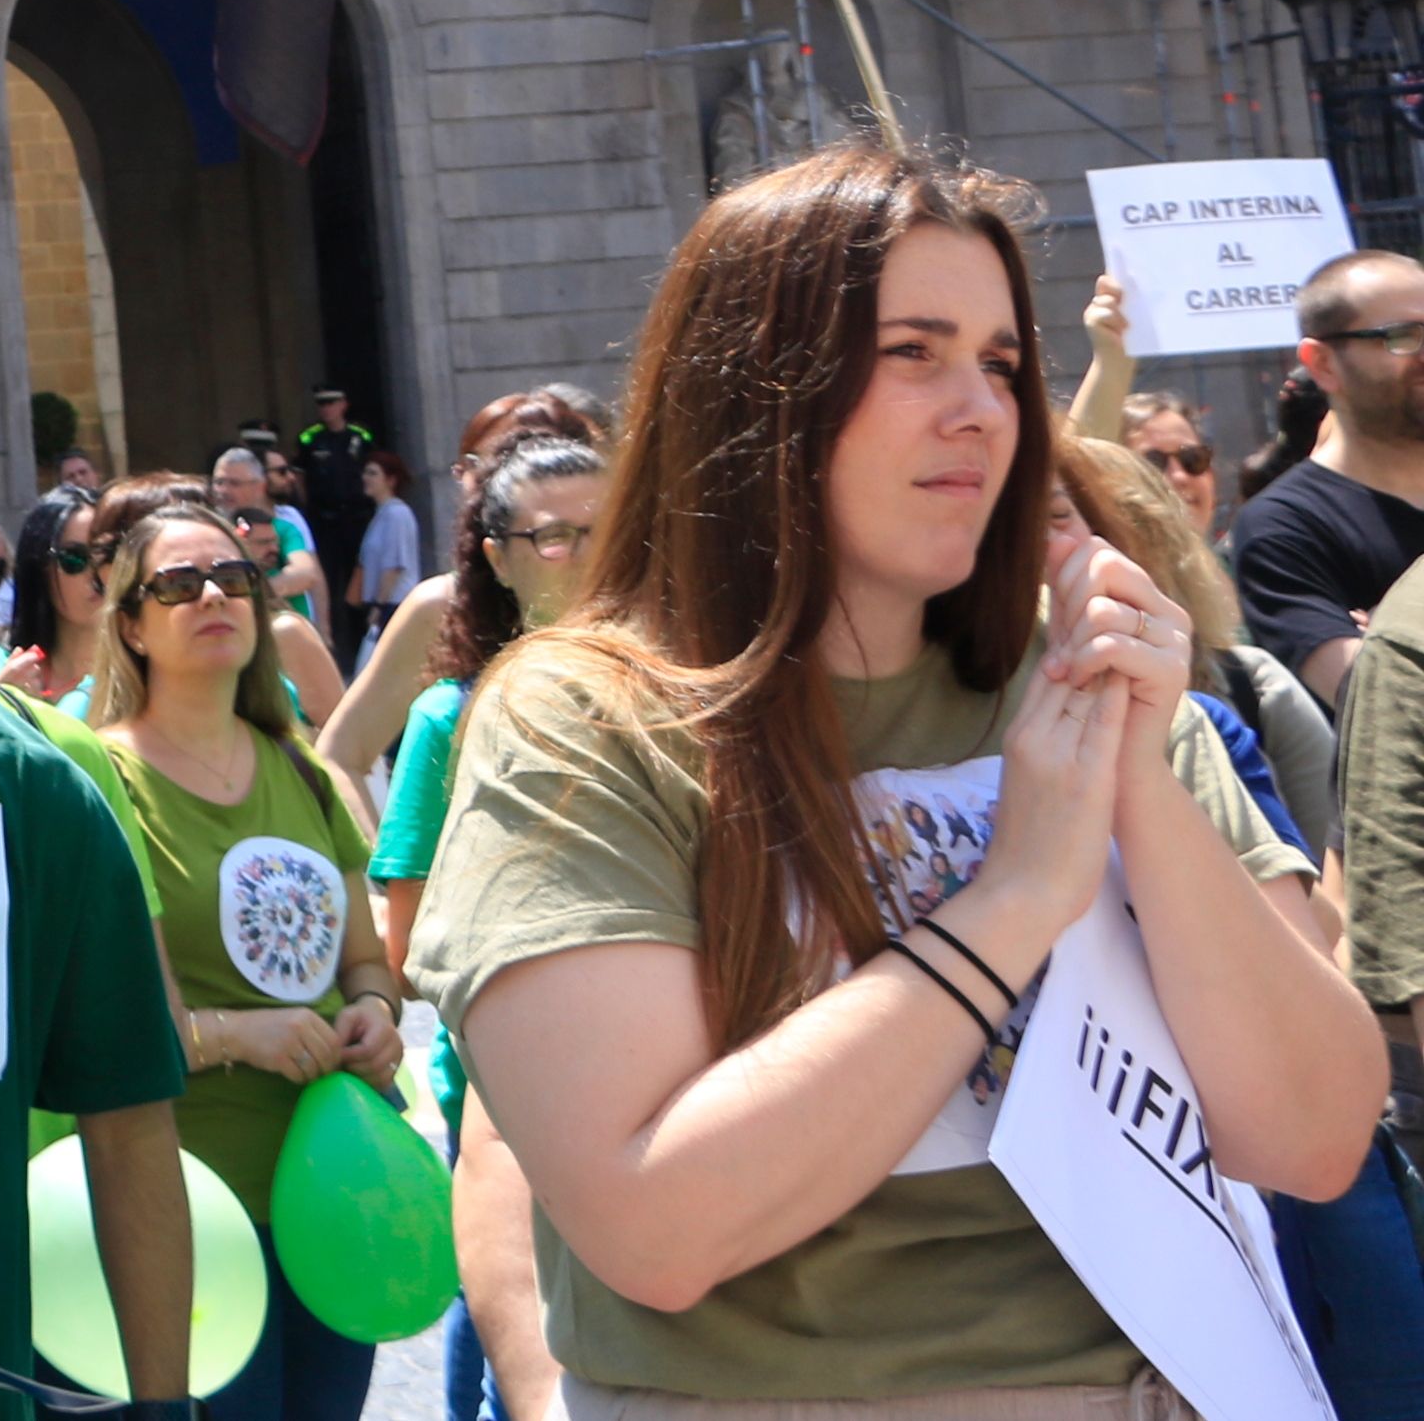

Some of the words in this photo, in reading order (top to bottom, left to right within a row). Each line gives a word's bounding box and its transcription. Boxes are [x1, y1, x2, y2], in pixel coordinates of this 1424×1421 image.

[1122, 202, 1180, 224] CAP
[1189, 195, 1321, 219] INTERINA
[1217, 241, 1254, 262] AL
[1185, 283, 1300, 310] CARRER
